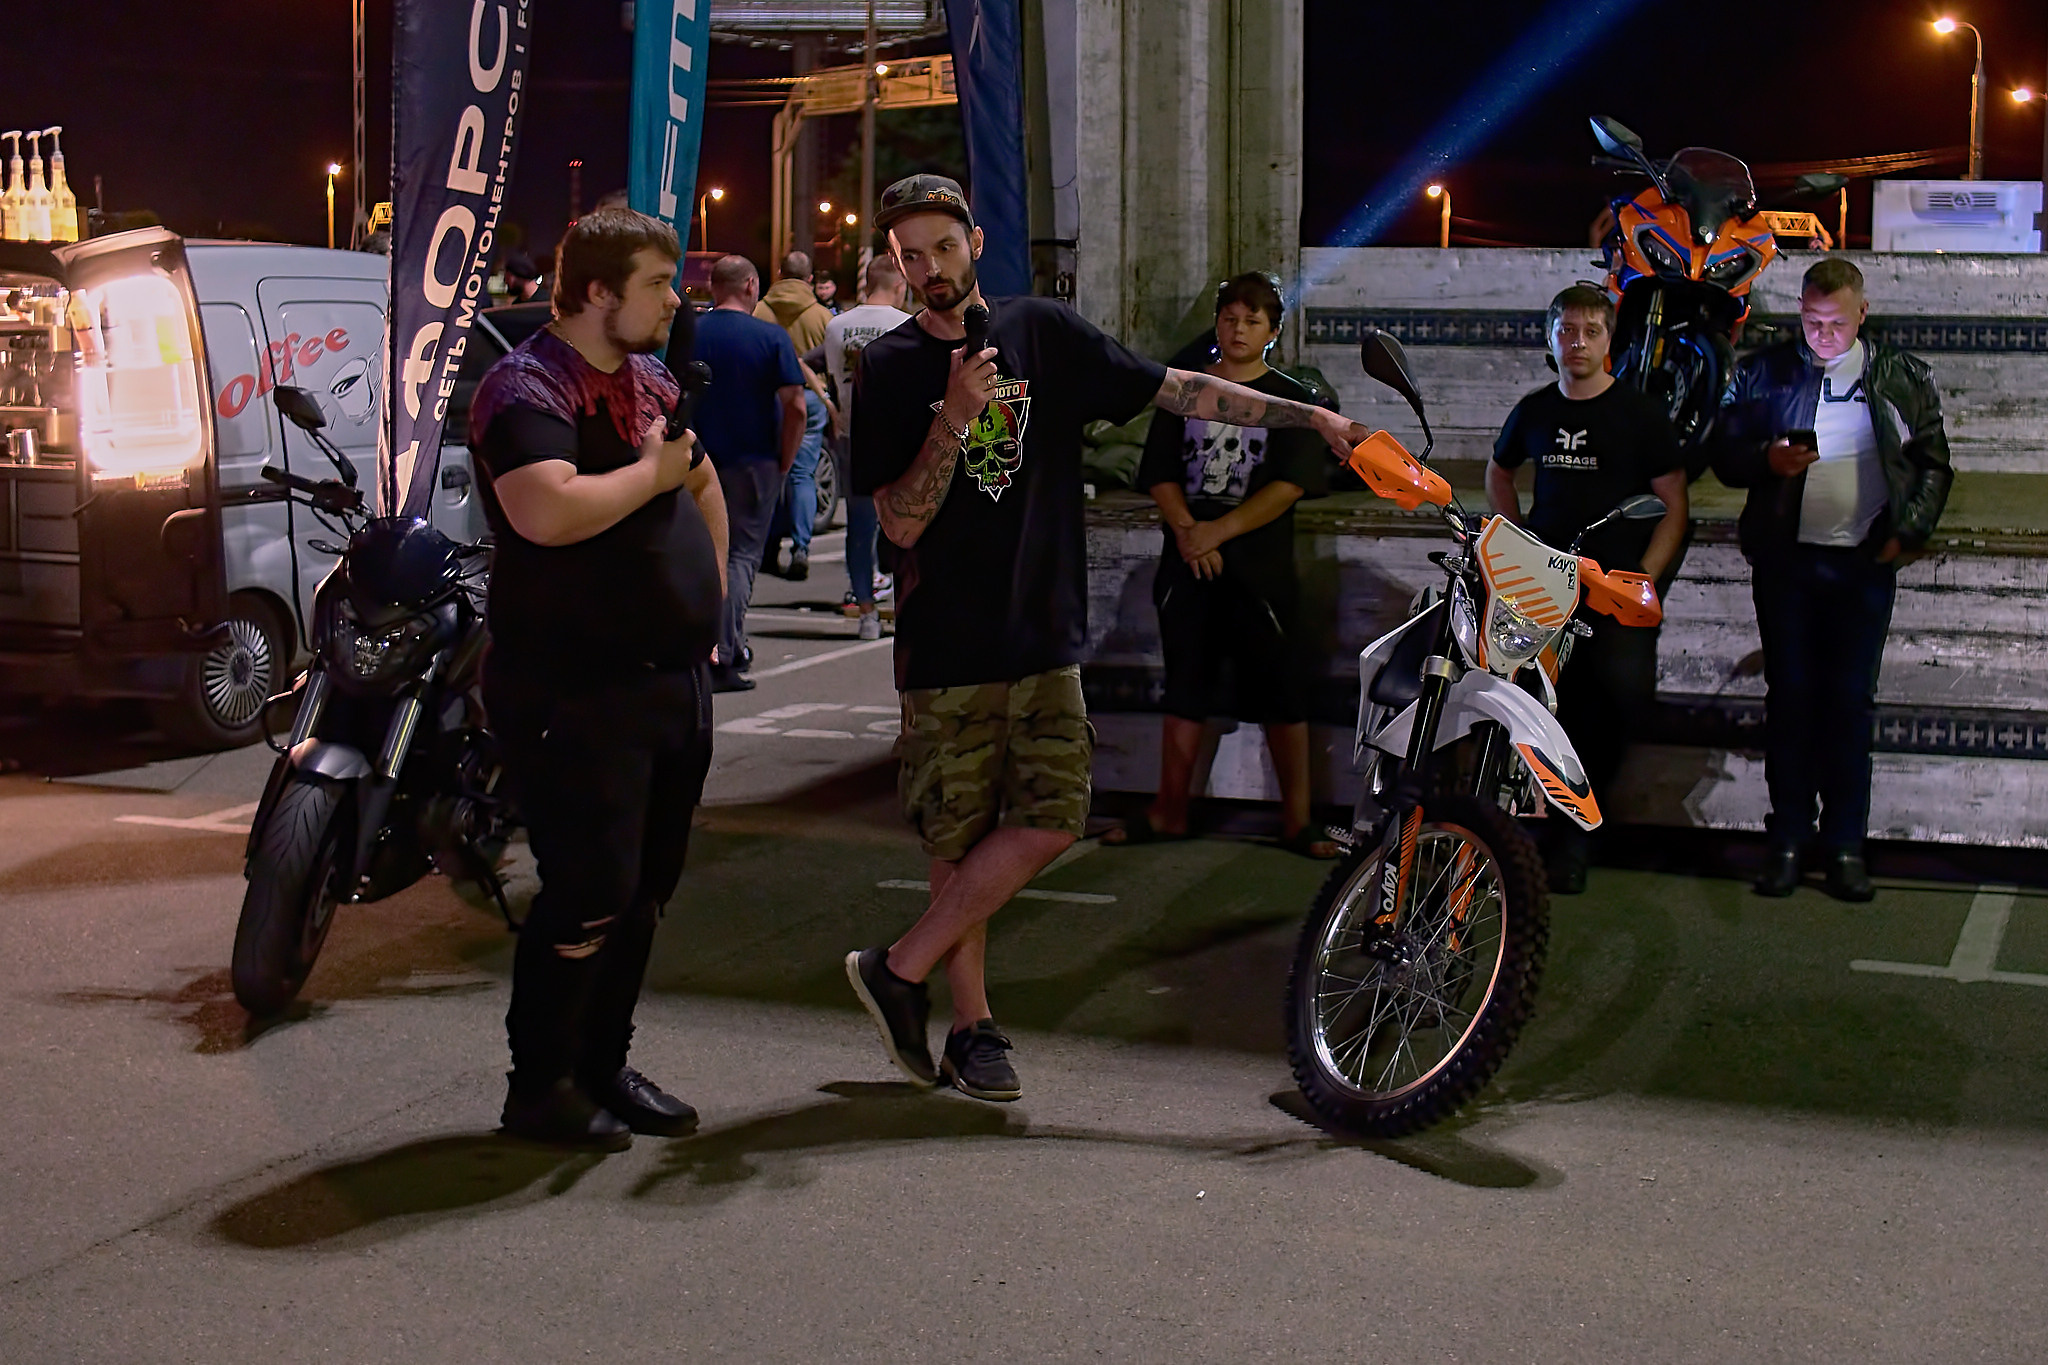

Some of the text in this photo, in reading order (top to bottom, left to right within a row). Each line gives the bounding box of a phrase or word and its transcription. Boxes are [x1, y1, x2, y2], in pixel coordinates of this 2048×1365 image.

[433, 336, 467, 422] СЕТЬ
[455, 69, 522, 329] МОТОЦЕНТРОВ
[217, 327, 350, 419] offee
[1823, 377, 1867, 402] LA
[1542, 454, 1598, 466] FORSAGE
[1547, 554, 1576, 573] KAYO
[1381, 861, 1399, 912] KAYO
